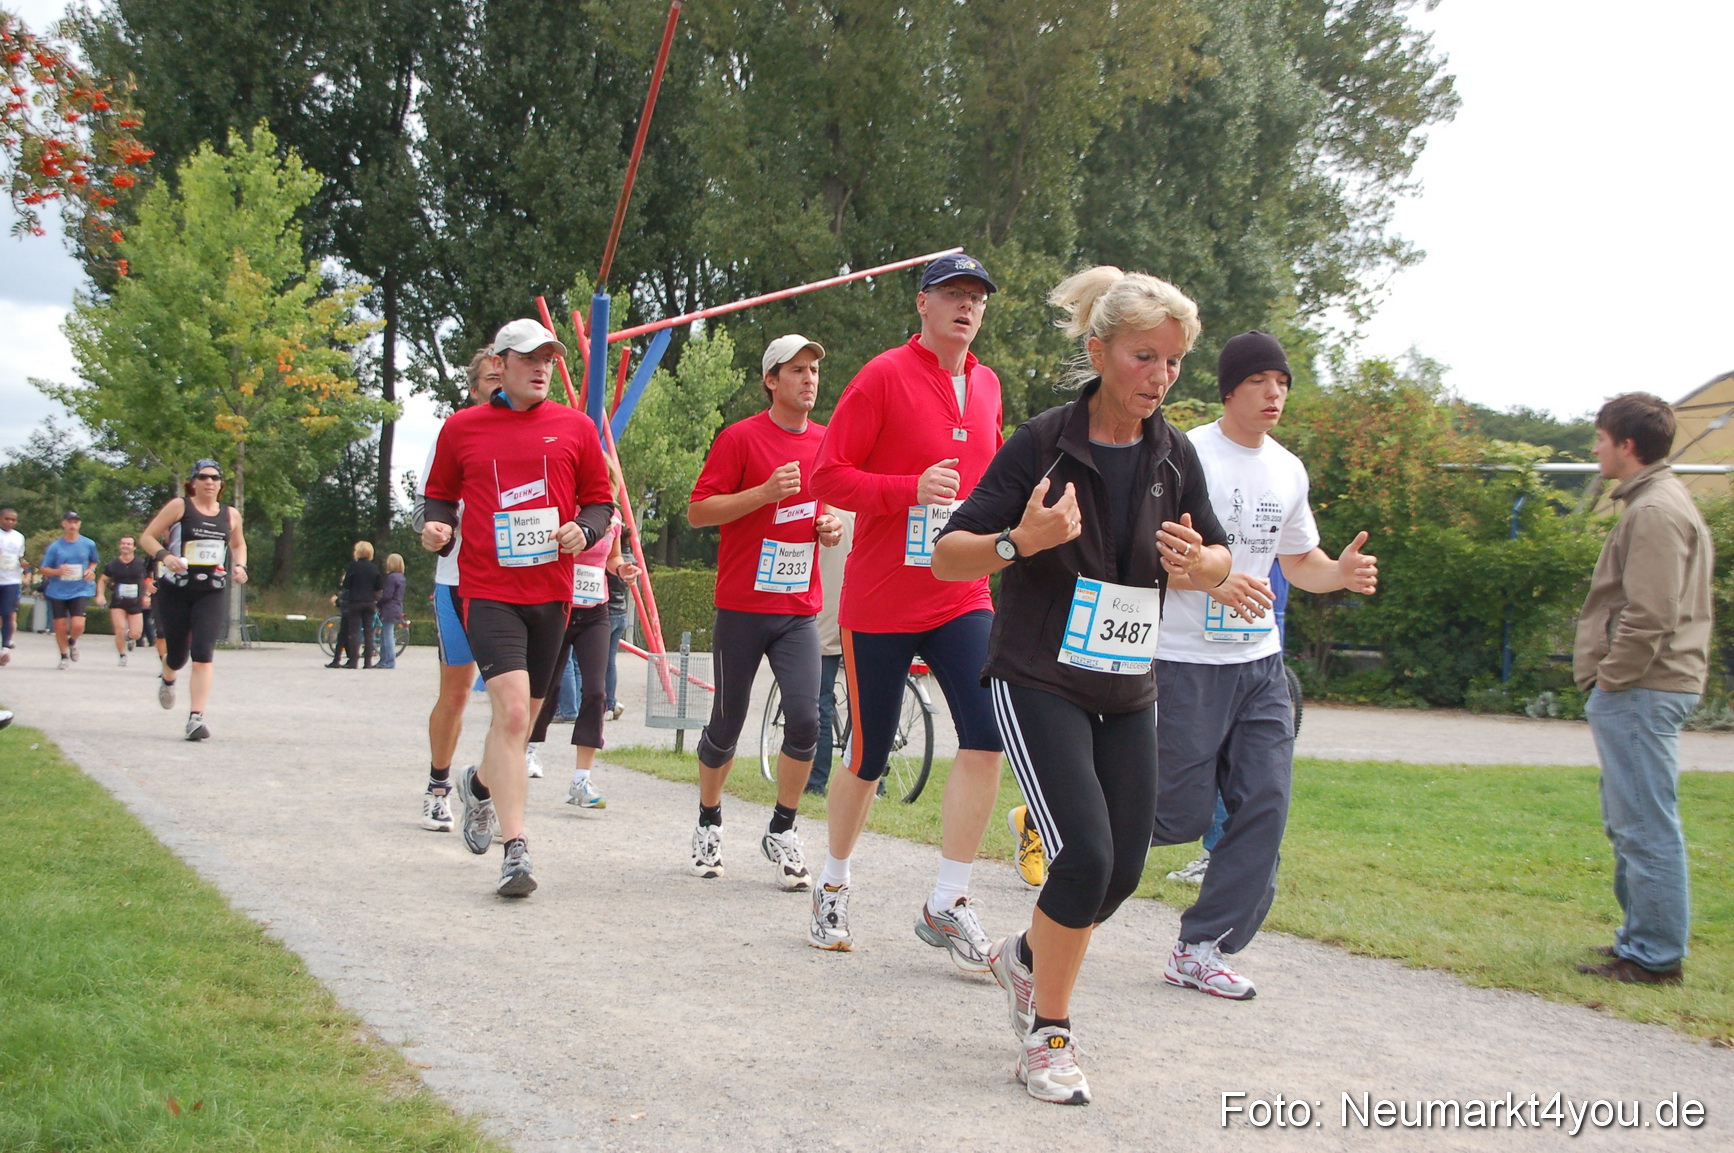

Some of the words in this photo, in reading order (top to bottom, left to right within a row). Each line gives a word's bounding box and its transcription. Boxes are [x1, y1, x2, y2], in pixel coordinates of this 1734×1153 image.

[513, 488, 533, 500] DEHN
[787, 508, 805, 517] DEHN
[514, 516, 540, 526] Martin
[913, 525, 918, 534] C
[516, 530, 553, 547] 2337
[1227, 533, 1238, 545] 9.
[199, 551, 217, 559] 674
[779, 548, 805, 558] Norbert
[777, 562, 807, 575] 2333
[575, 580, 601, 592] 3257
[1112, 598, 1140, 613] Rosi
[1099, 619, 1152, 644] 3487
